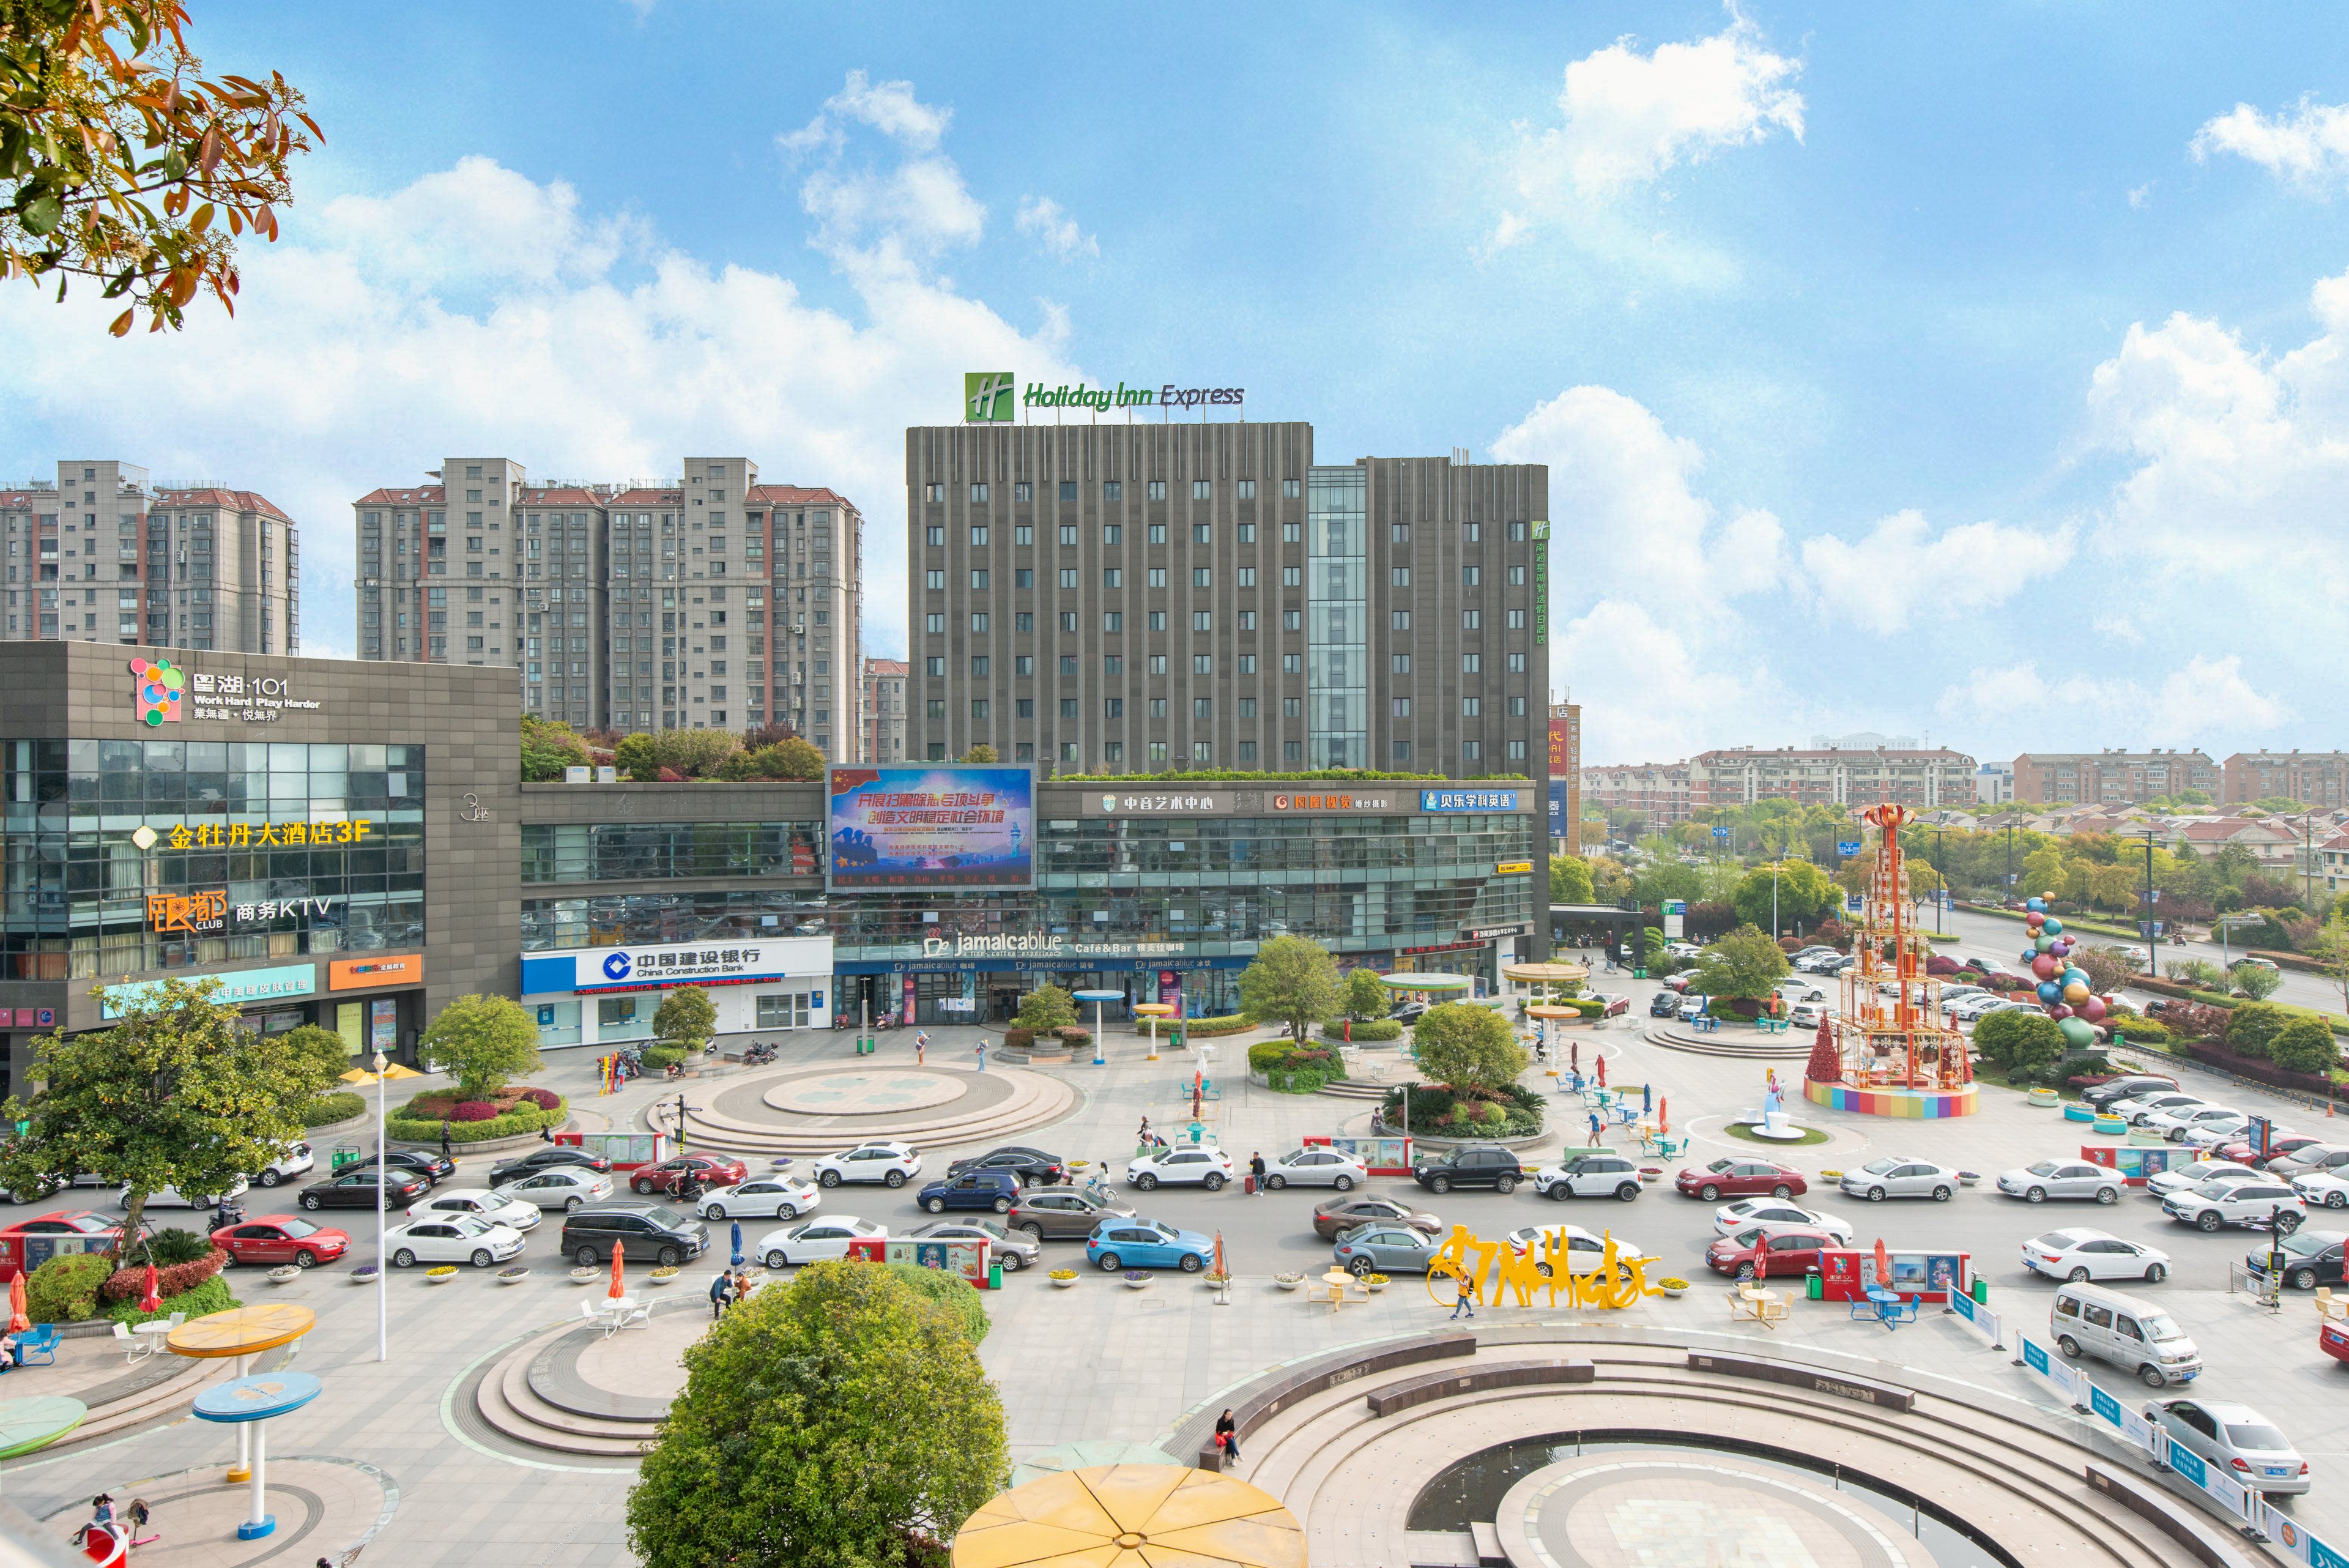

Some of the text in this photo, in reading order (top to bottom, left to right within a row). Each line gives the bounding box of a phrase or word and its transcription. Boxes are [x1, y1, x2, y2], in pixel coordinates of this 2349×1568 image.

[1023, 382, 1245, 413] Holiday Inn Express
[1535, 543, 1546, 644] 南通星湖智选假日酒店
[194, 695, 321, 709] Work Hard Play Harder
[858, 793, 995, 808] 开展扫黑除恶专项斗争
[1124, 796, 1214, 811] 中音艺术中心
[1354, 799, 1388, 808] 婚纱摄影
[867, 810, 1005, 825] 创造文明稳定社会环境
[196, 920, 223, 931] CLUB
[954, 931, 1062, 957] jamaicablue
[1137, 943, 1185, 953] 雅美佳咖啡
[637, 949, 761, 968] 中国建设银行
[1028, 959, 1077, 970] jamaicablue
[1148, 959, 1195, 970] jamaicablue
[637, 964, 744, 978] China Construction Bank
[907, 960, 957, 972] jamaicablue
